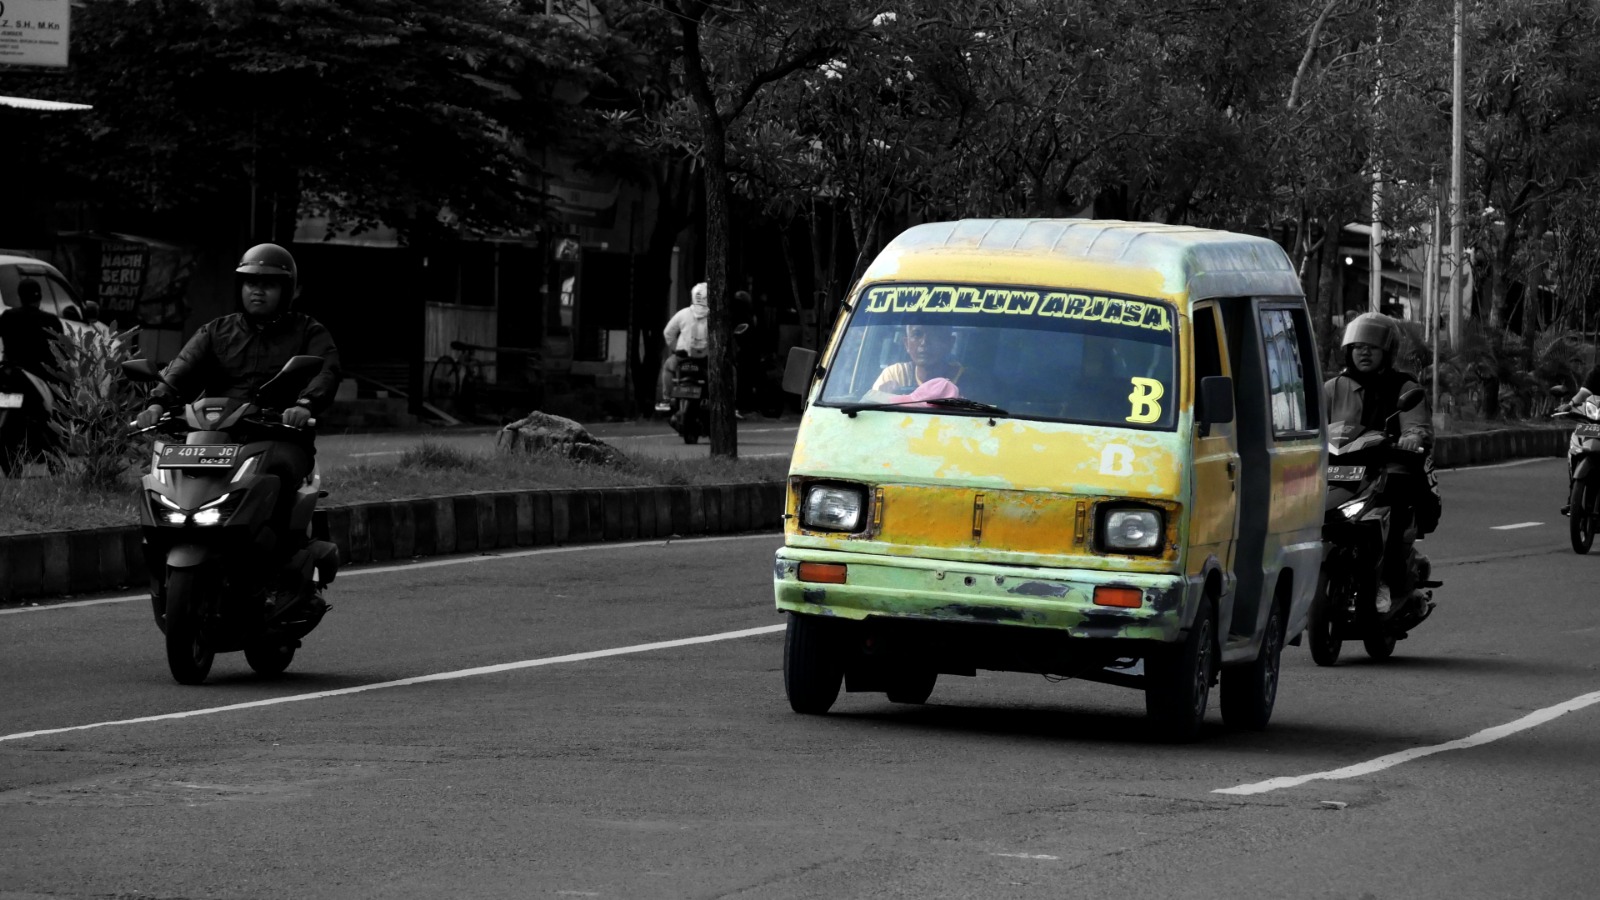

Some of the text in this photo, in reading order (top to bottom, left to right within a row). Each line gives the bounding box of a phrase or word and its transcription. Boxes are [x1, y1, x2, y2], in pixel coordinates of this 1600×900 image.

[102, 268, 140, 284] SERU
[1037, 292, 1172, 333] ARJASA
[1125, 376, 1165, 424] B
[165, 447, 234, 456] P 4012 JC
[1099, 443, 1136, 477] B
